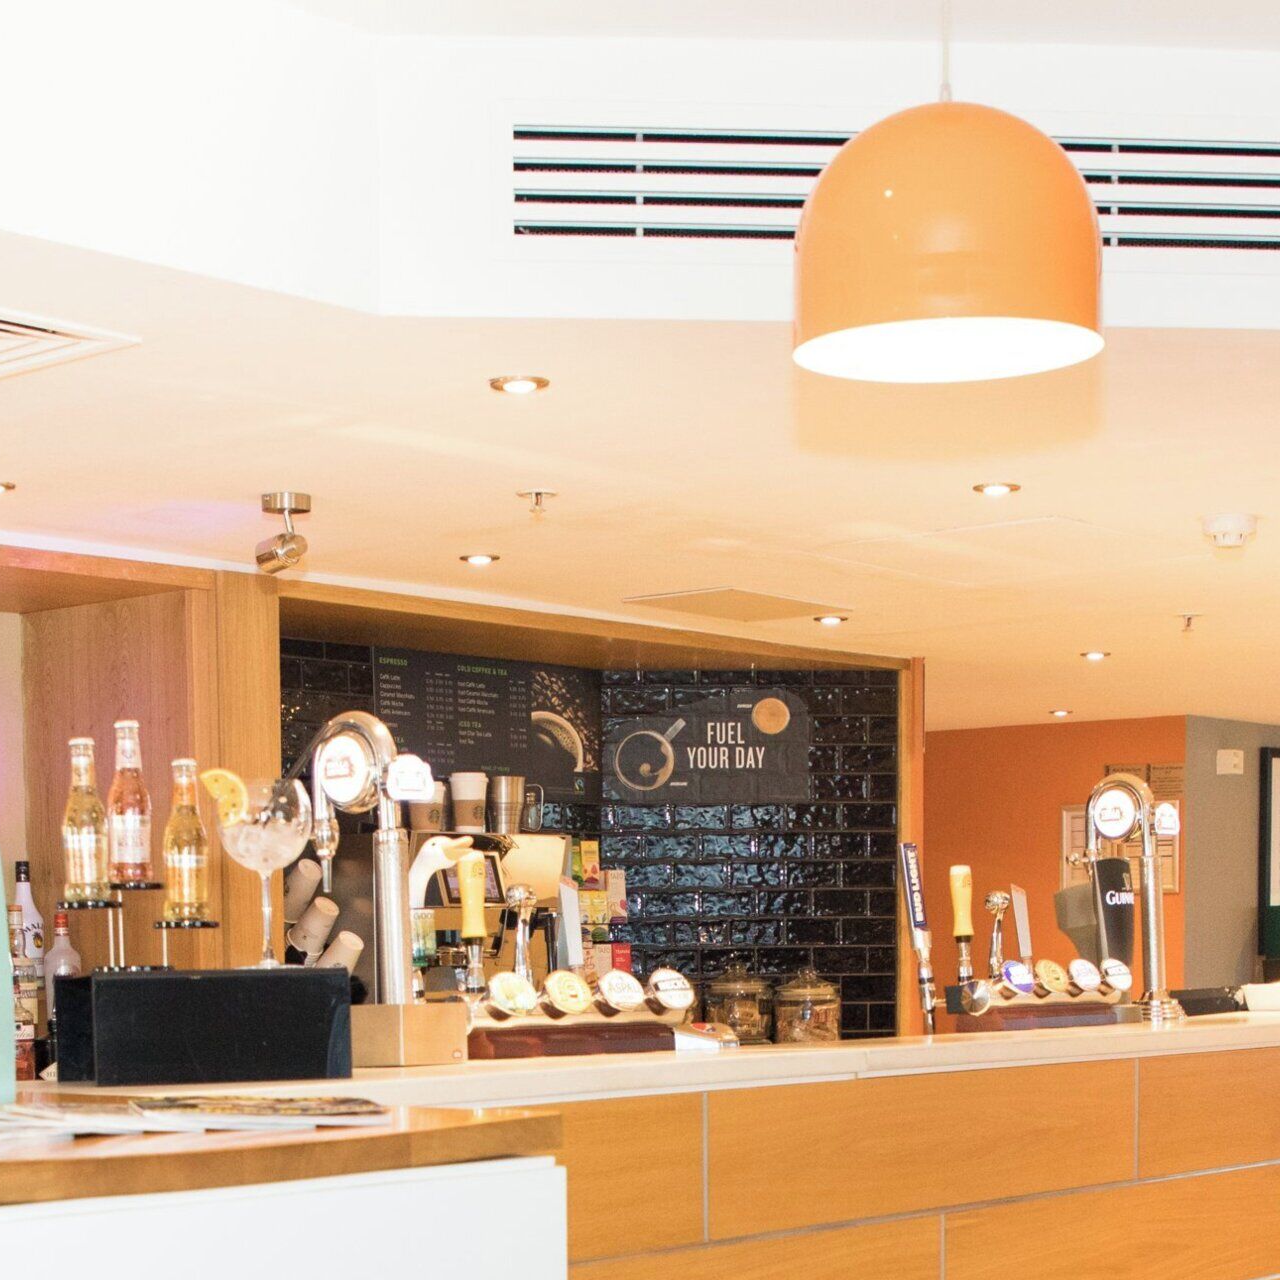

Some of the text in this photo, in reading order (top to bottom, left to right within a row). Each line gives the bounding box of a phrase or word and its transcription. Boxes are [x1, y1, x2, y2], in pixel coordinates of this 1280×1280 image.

[707, 722, 745, 744] FUEL
[687, 746, 765, 769] YOUR DAY
[907, 850, 924, 922] BUD LIGHT
